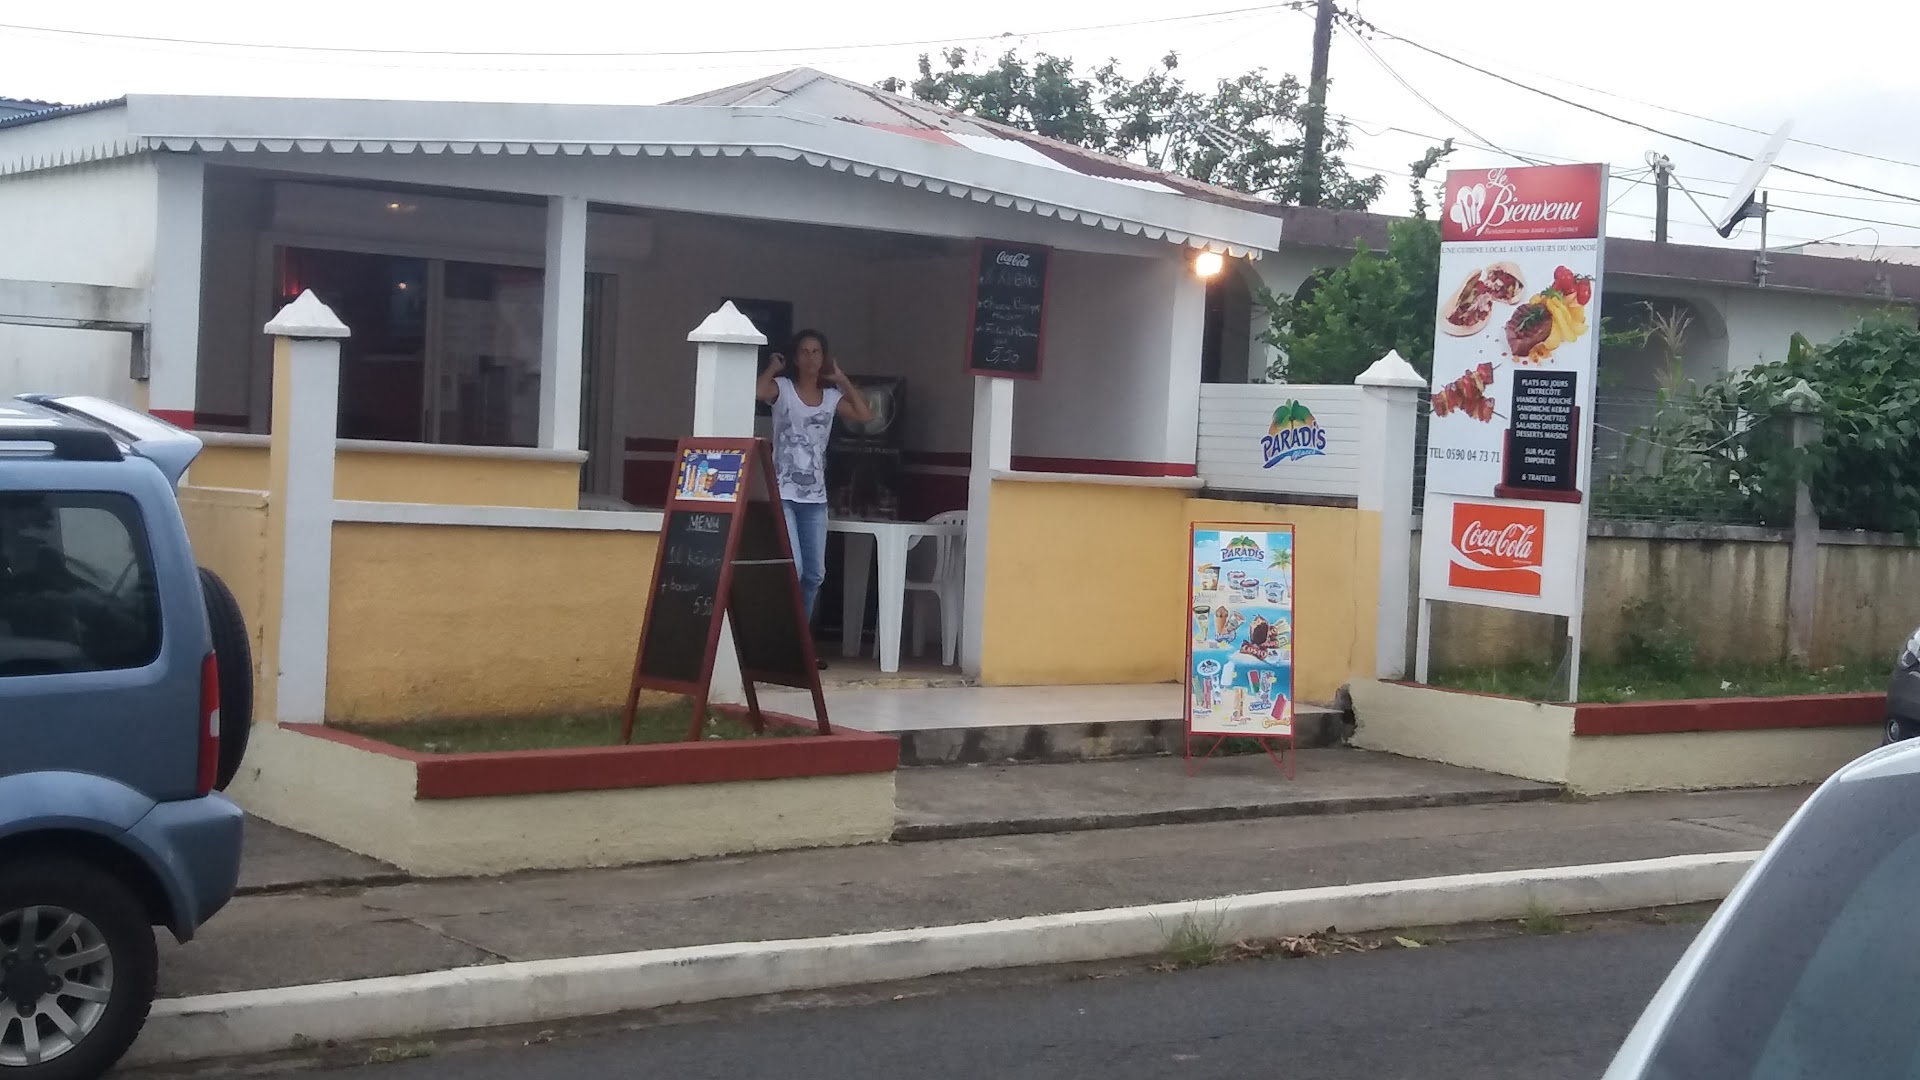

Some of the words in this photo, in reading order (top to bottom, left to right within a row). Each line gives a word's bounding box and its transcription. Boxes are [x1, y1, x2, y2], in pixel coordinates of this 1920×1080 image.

[1486, 168, 1507, 189] Le
[1475, 183, 1583, 236] Bienvenu
[1557, 244, 1567, 252] DU
[1569, 243, 1597, 251] MONDE
[996, 250, 1030, 268] Coca-Cola
[1521, 379, 1539, 387] PLATS
[1540, 379, 1549, 387] DU
[1550, 380, 1569, 388] JOURS
[1551, 406, 1570, 414] KEBAB
[1529, 414, 1566, 422] BROCHETTES
[1516, 421, 1541, 430] SALADES
[1542, 423, 1569, 431] DIVERSES
[1515, 430, 1543, 438] DESSERTS
[1544, 431, 1568, 439] MAISON
[1260, 421, 1326, 462] PARADIS
[1446, 448, 1465, 461] 0590
[1467, 449, 1477, 461] 04
[1479, 450, 1489, 462] 73
[1491, 451, 1501, 463] 71
[1525, 447, 1537, 455] SUR
[1537, 448, 1556, 457] PLACE
[1524, 456, 1556, 465] EMPORTER
[1527, 473, 1556, 483] TRAITEUR
[688, 514, 720, 530] MENU
[1460, 520, 1538, 559] Coca-Cola
[1220, 547, 1265, 560] PARADIS
